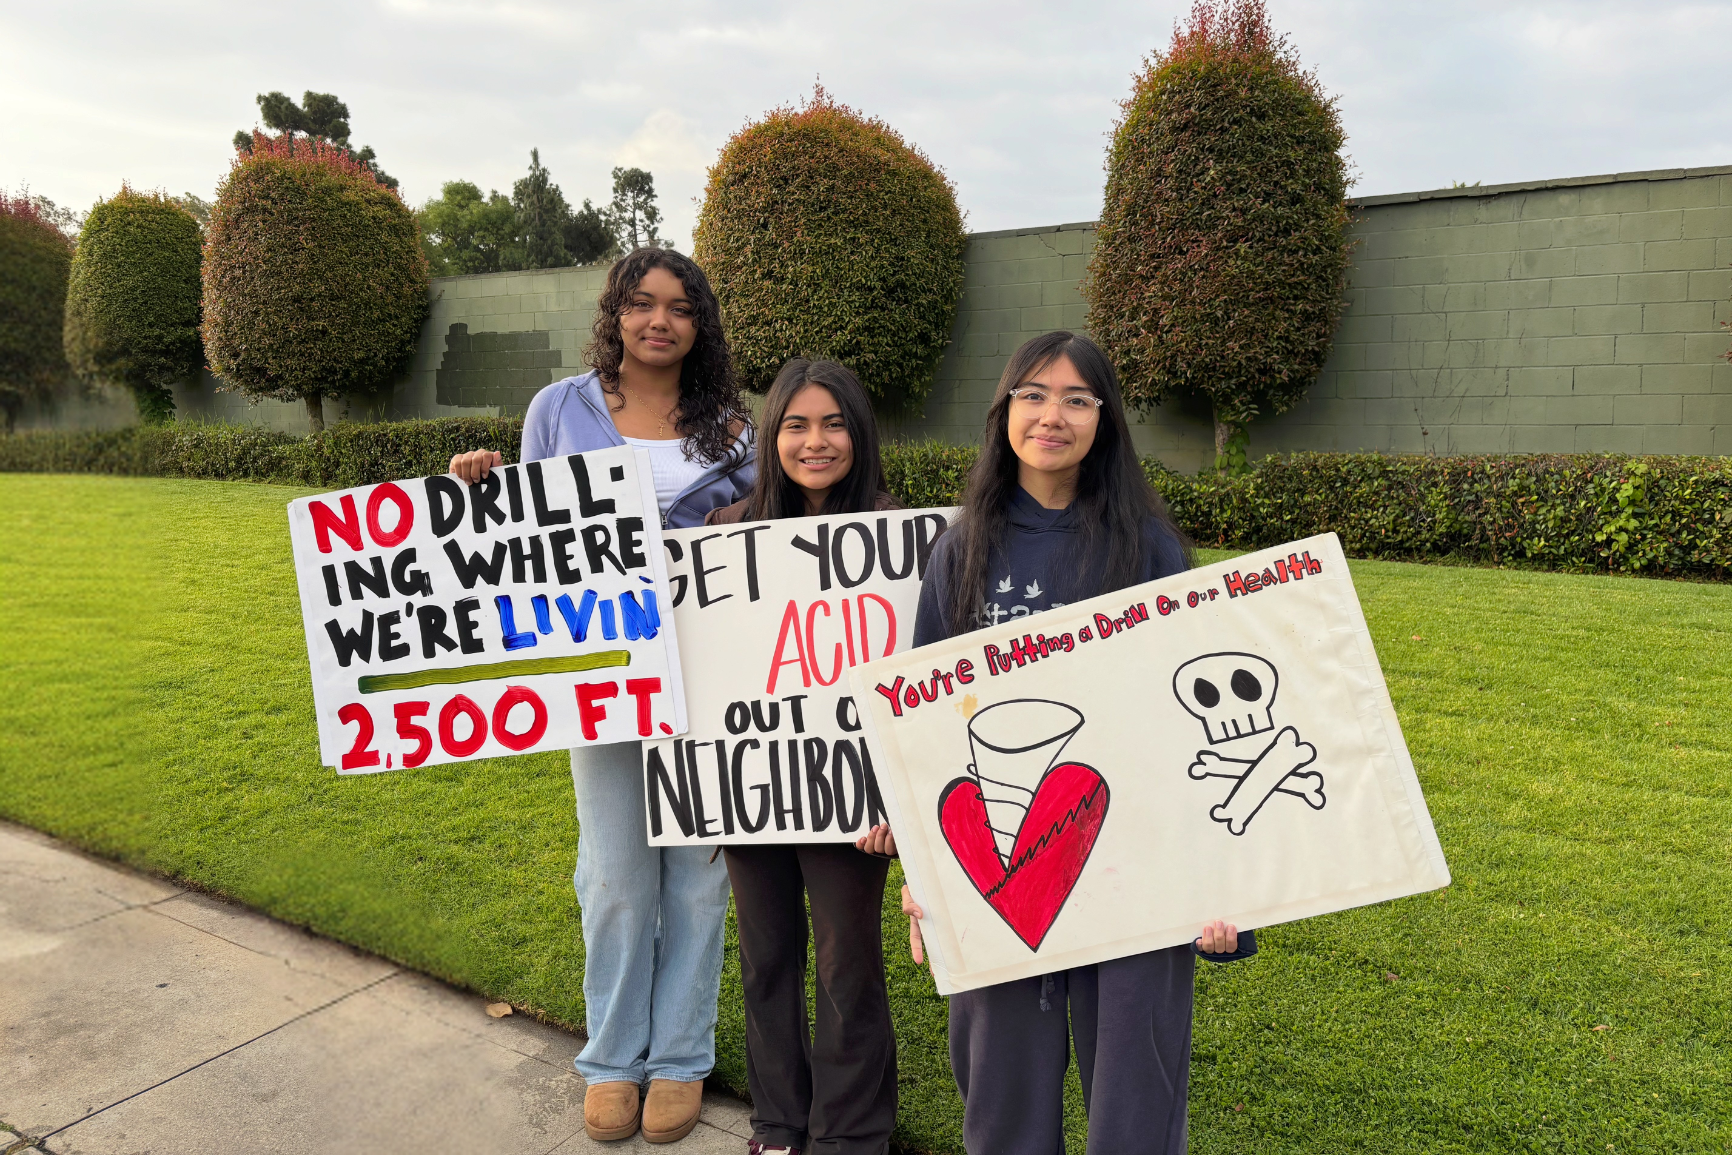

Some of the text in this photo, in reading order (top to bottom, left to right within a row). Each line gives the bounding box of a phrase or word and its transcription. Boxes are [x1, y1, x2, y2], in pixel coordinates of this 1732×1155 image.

[308, 482, 414, 553] NO
[322, 516, 646, 606] ING WHERE
[324, 597, 484, 667] WE'RE
[766, 592, 897, 696] ACID
[875, 659, 975, 717] You're
[984, 633, 1075, 676] Putting
[1078, 625, 1093, 643] a
[1093, 602, 1150, 639] Drill
[1156, 595, 1180, 616] On
[1223, 550, 1322, 599] Health
[338, 677, 673, 771] 2,500 FT.
[725, 694, 808, 735] OUT
